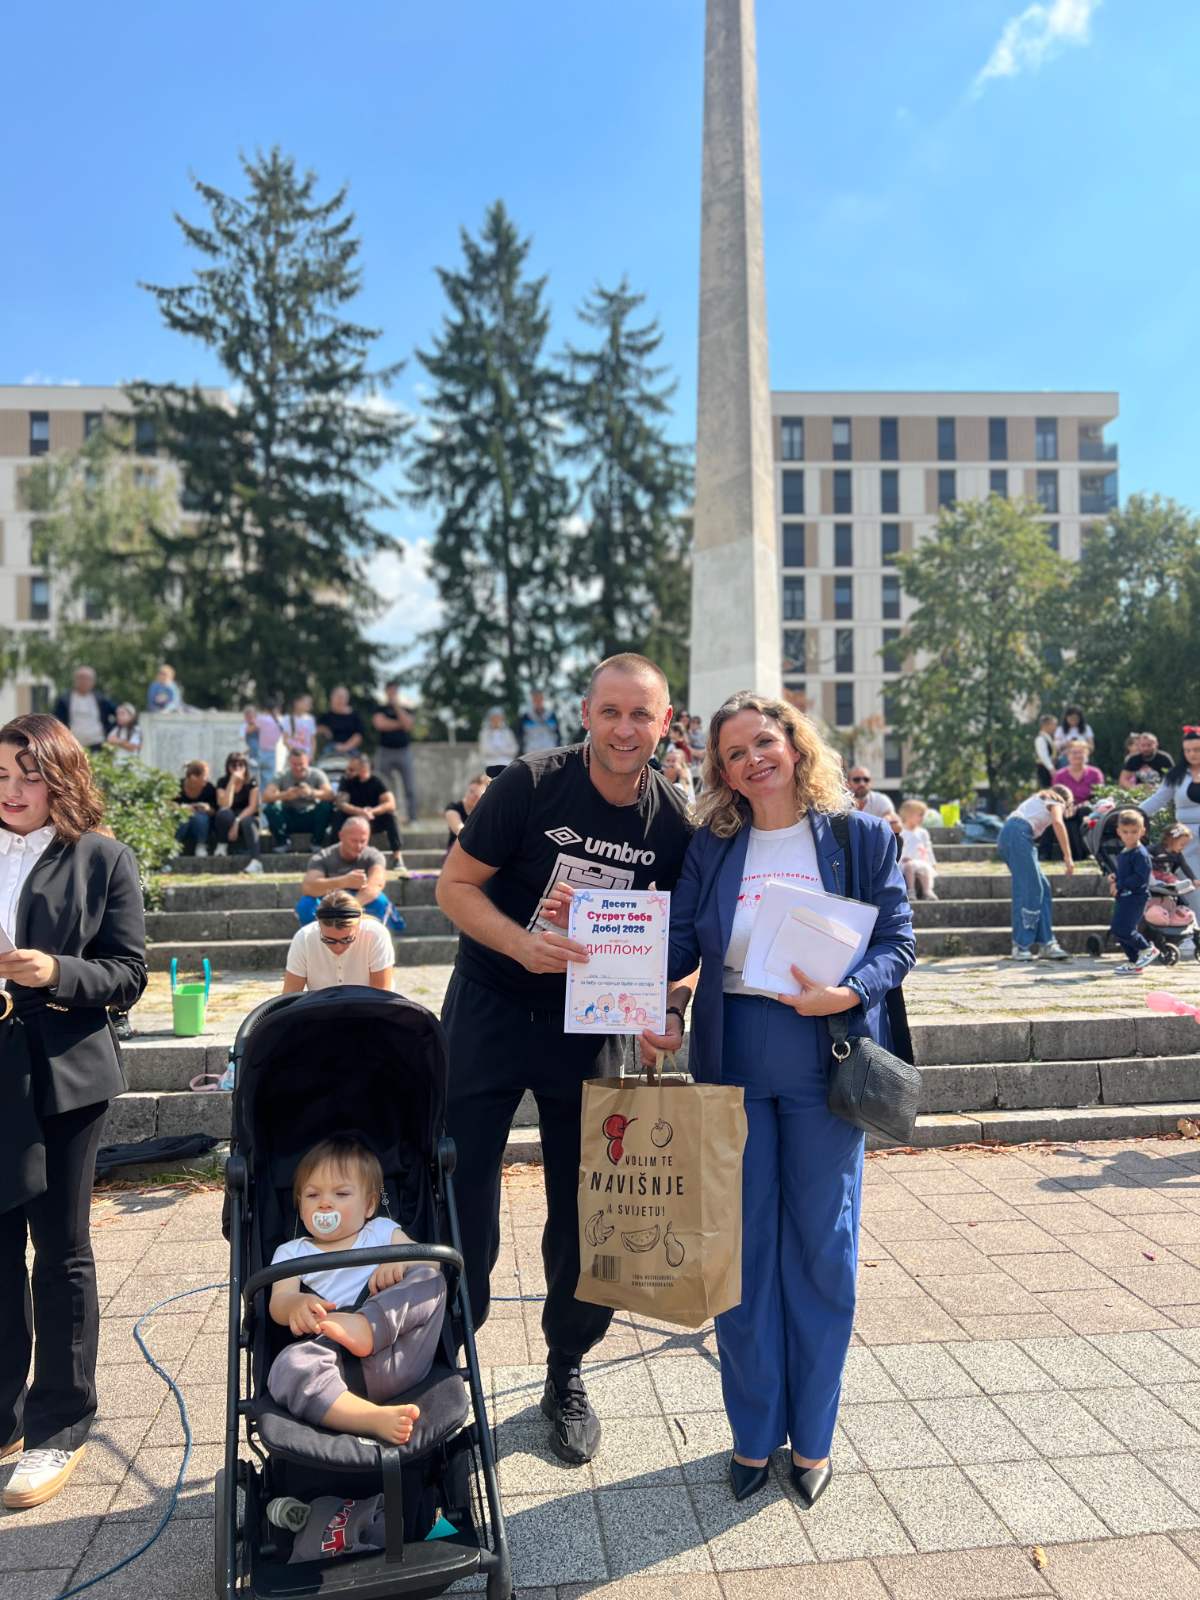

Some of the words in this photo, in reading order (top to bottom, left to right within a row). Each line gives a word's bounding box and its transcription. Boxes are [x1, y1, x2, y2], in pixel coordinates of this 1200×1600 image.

[585, 837, 656, 866] umbro
[602, 899, 638, 910] Десети
[587, 911, 625, 922] Сусрет
[628, 913, 653, 922] беба
[592, 924, 621, 934] Добој
[587, 944, 653, 956] ДИПЛОМУ
[625, 1154, 657, 1167] VOLIM
[662, 1156, 673, 1167] TE
[590, 1171, 684, 1196] NAVIŠNJE
[618, 1204, 665, 1217] SVIJETU!
